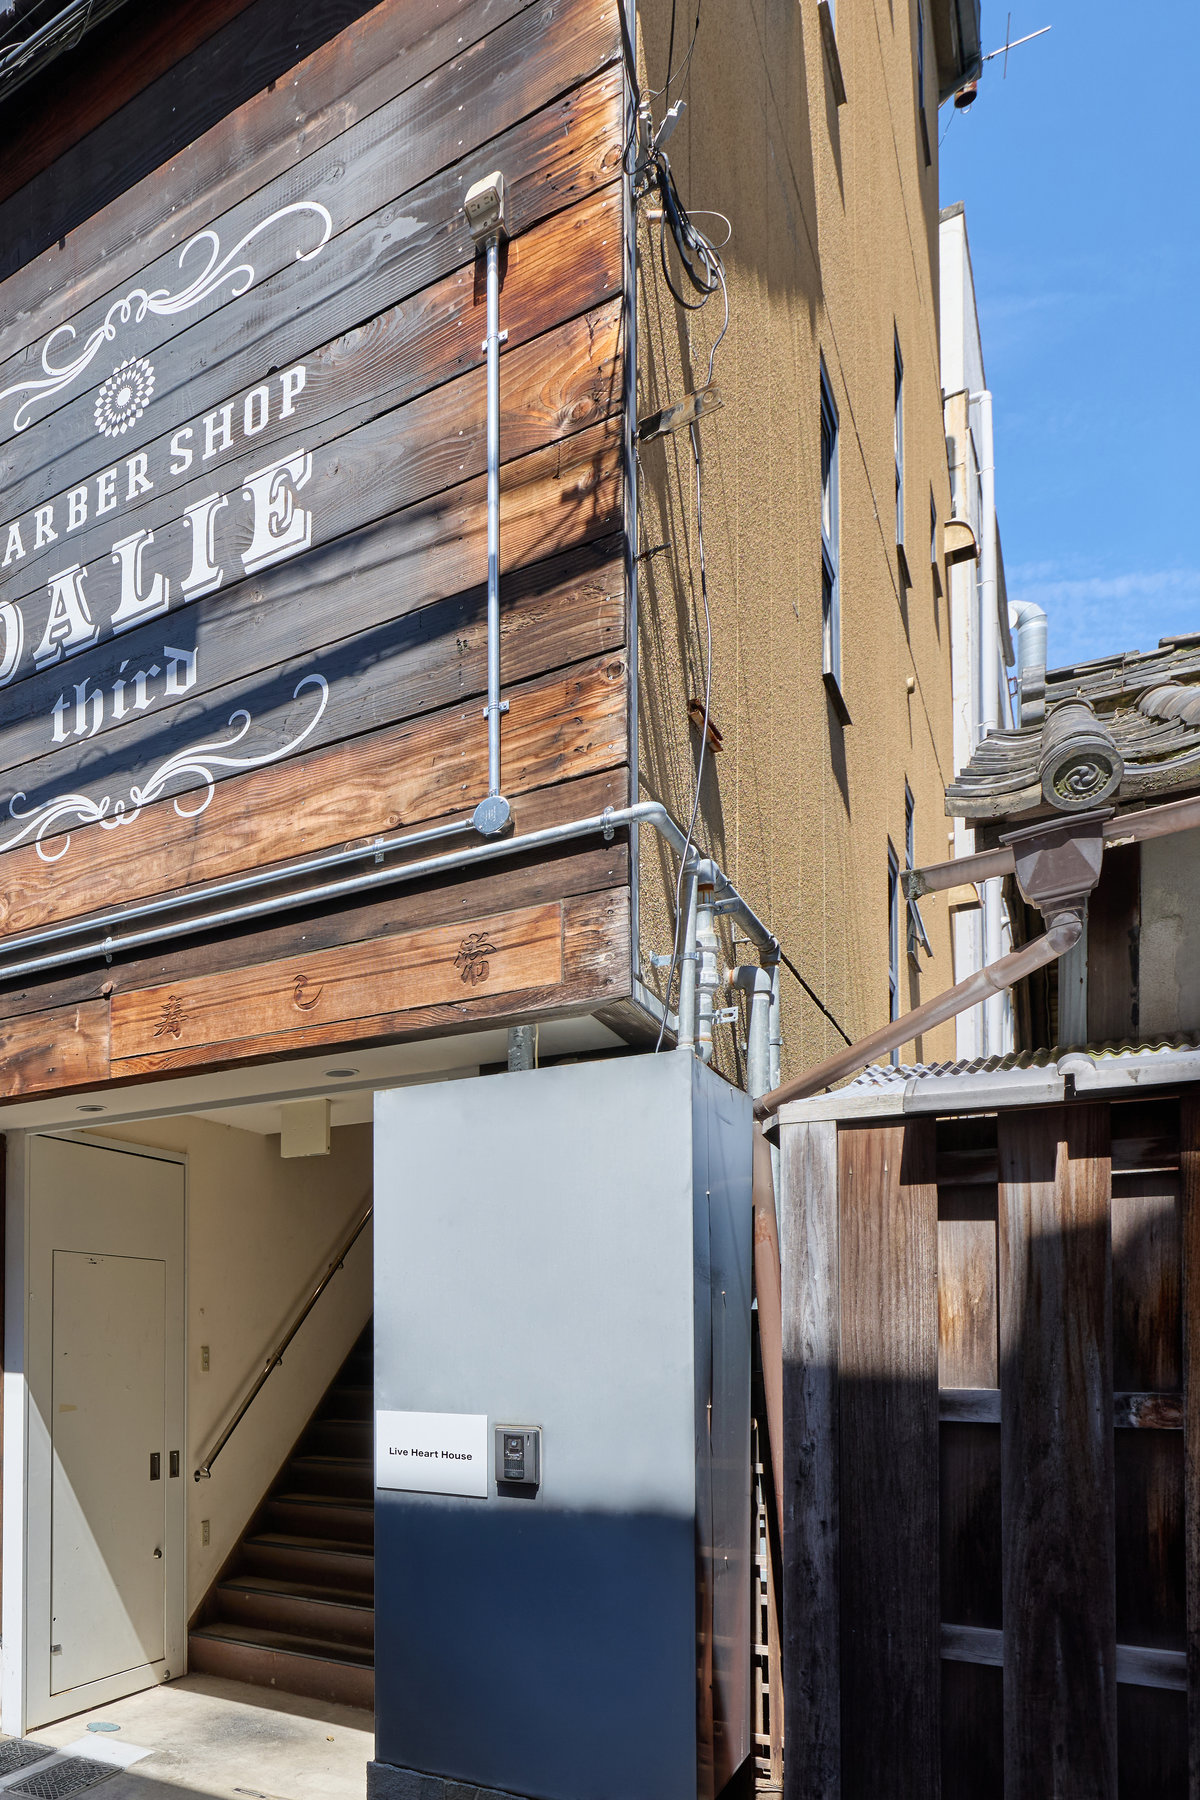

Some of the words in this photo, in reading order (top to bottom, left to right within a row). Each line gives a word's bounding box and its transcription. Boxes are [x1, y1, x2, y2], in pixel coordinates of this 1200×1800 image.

[169, 365, 307, 476] SHOP
[50, 645, 199, 744] third
[389, 1447, 408, 1456] Live
[411, 1449, 438, 1458] Heart
[441, 1451, 472, 1460] House
